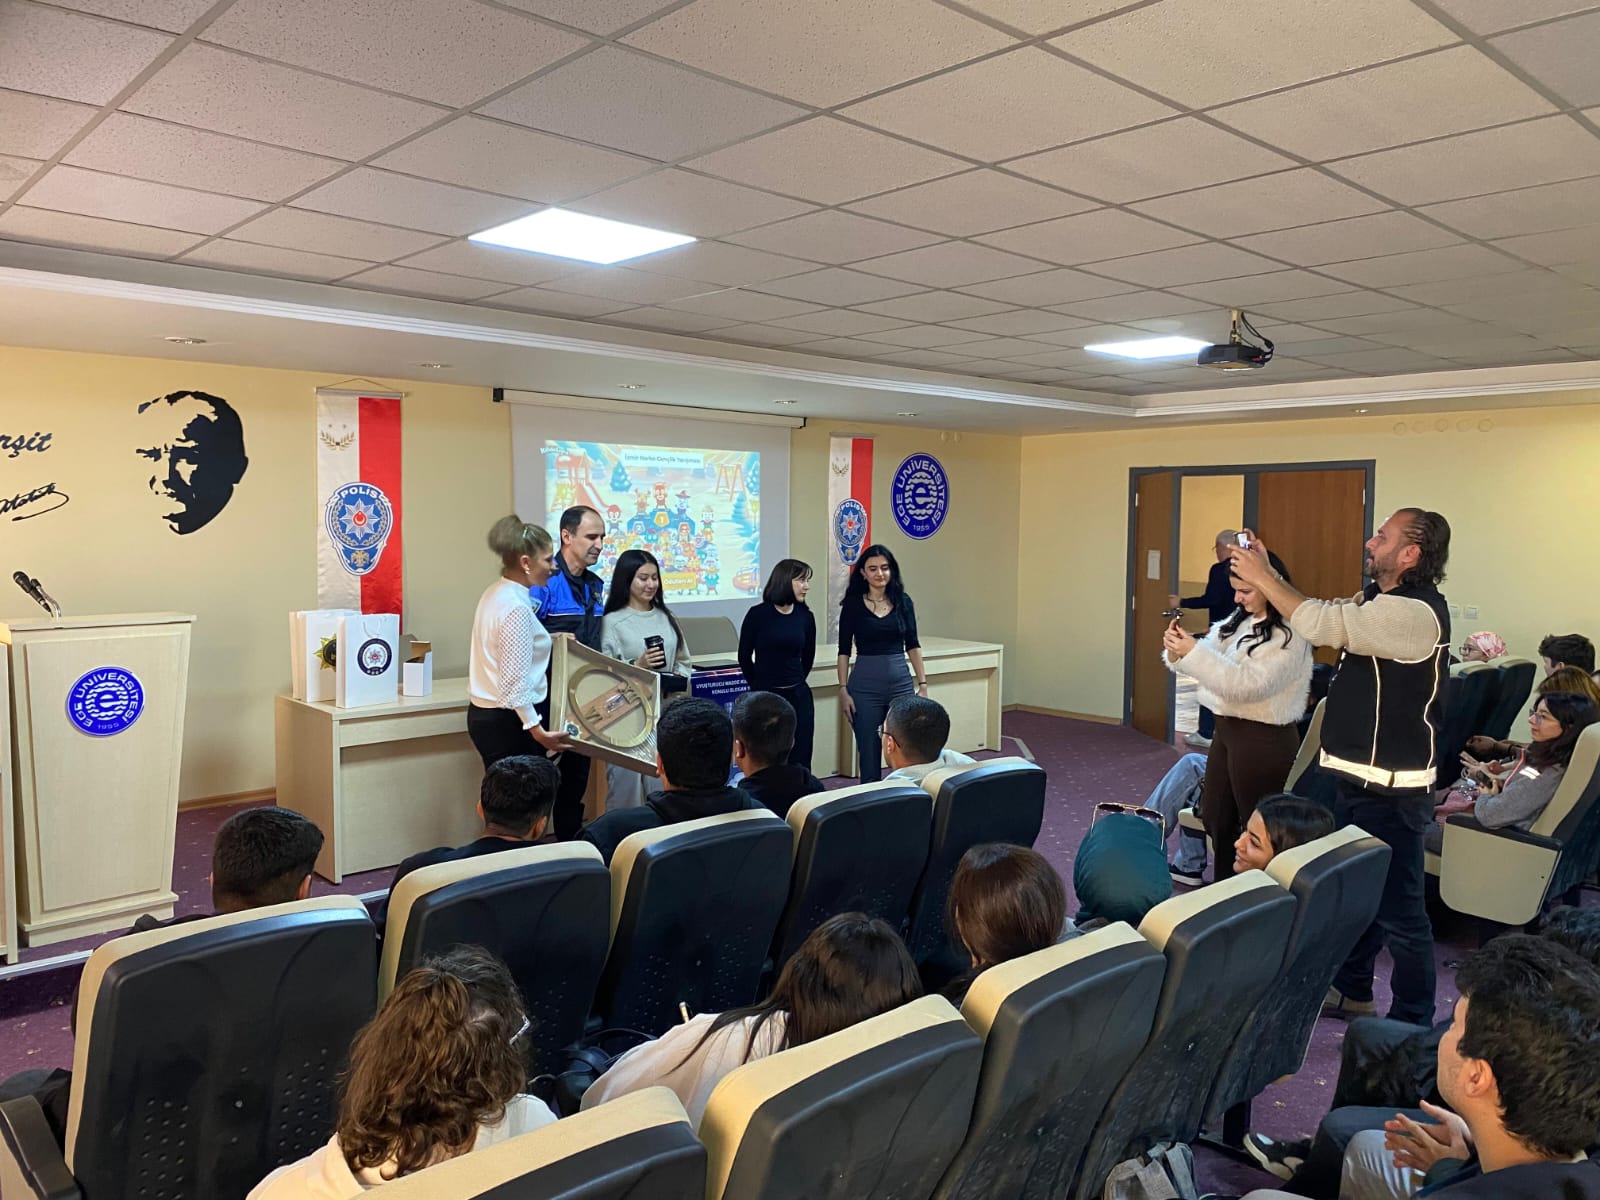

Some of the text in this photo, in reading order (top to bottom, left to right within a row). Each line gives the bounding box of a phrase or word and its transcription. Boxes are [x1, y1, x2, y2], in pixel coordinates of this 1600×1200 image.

[0, 431, 53, 458] rşit
[340, 486, 379, 499] POLİS
[895, 493, 911, 527] EGE
[912, 524, 931, 532] 1955
[696, 681, 725, 689] UYUŞTURUCU
[74, 702, 94, 728] EGE
